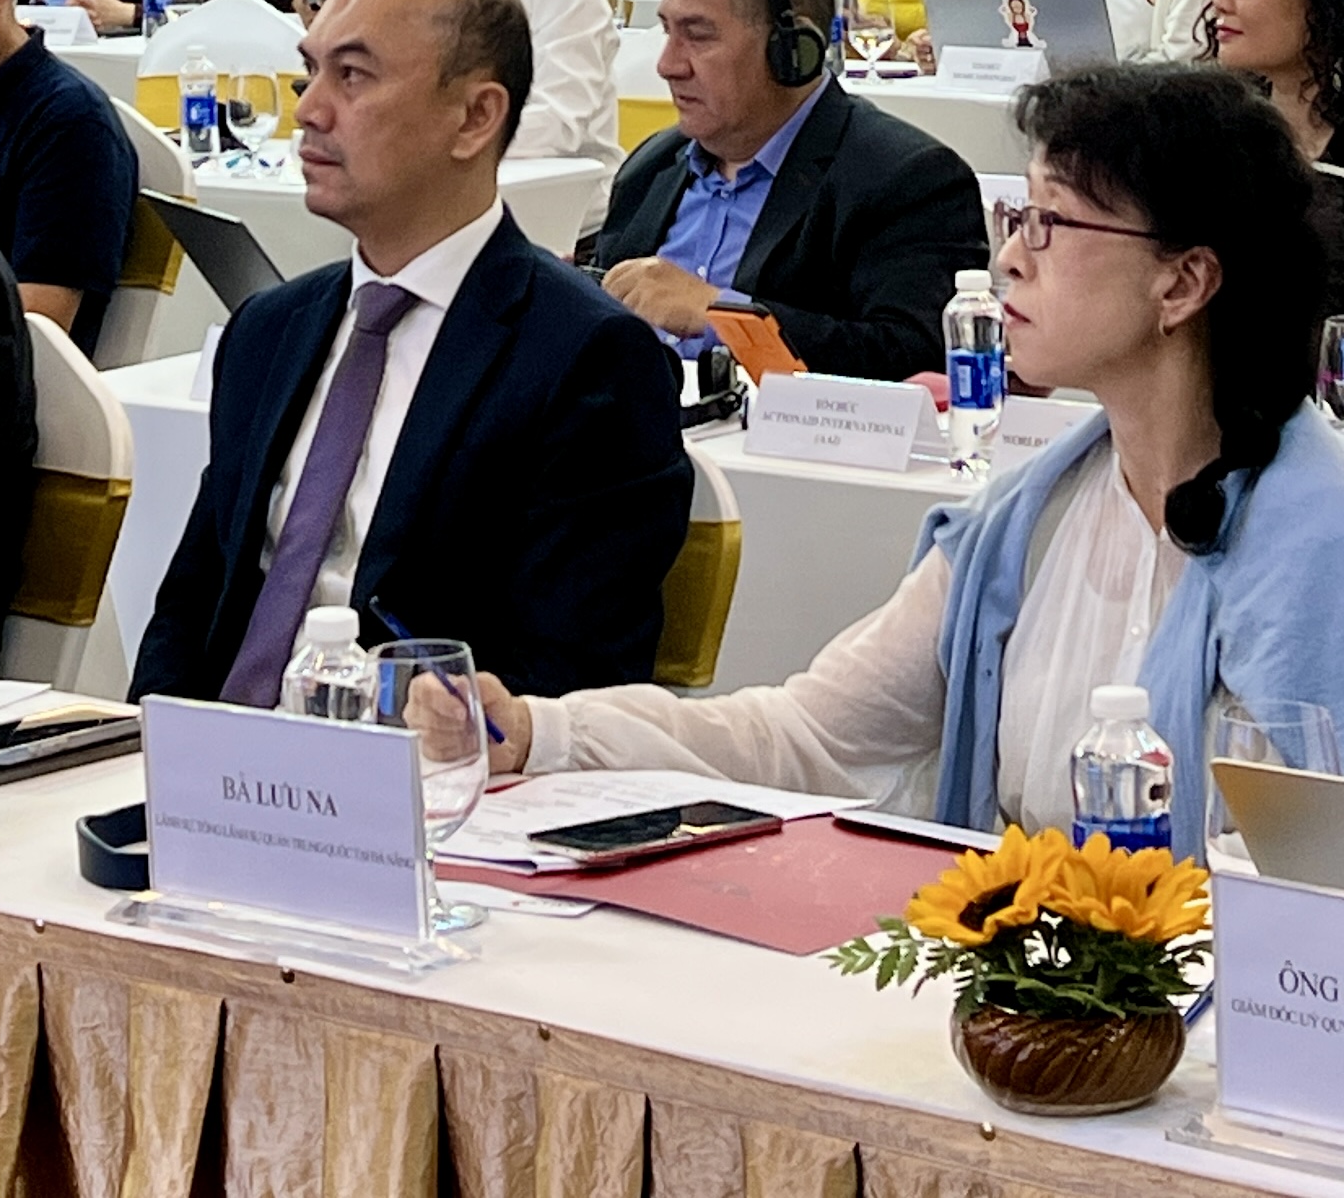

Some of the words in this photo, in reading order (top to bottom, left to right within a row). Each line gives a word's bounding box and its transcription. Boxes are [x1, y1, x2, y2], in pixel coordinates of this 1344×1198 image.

[819, 415, 905, 437] INTERNATIONAL
[257, 781, 301, 811] LƯU
[307, 789, 338, 818] NA
[1278, 960, 1338, 1003] ÔNG
